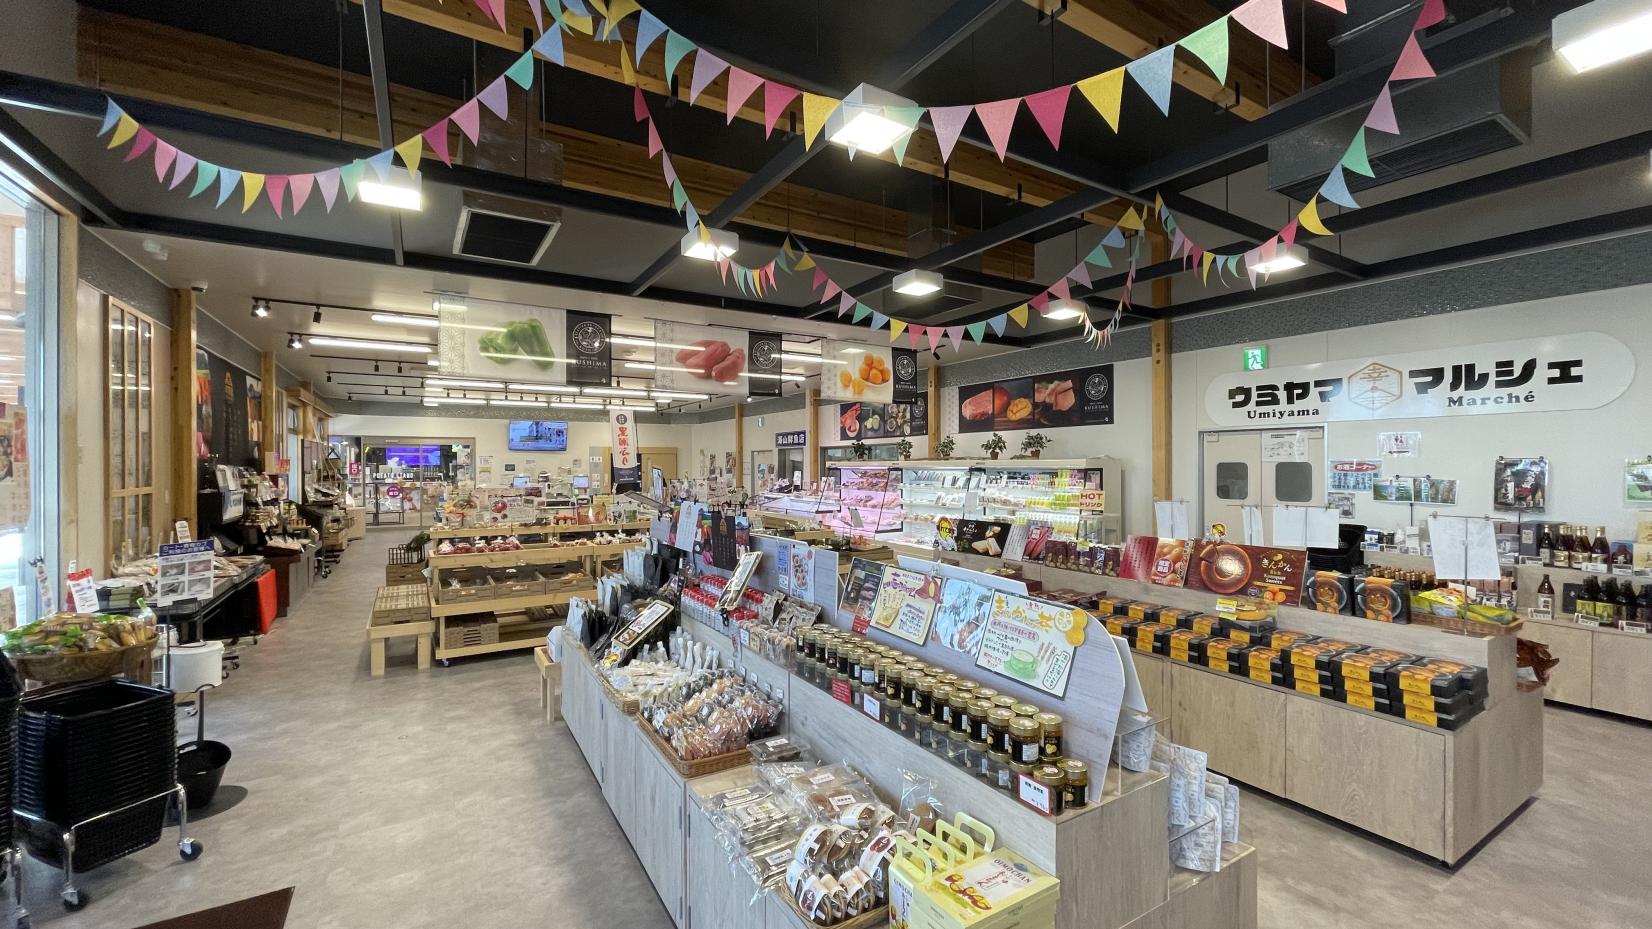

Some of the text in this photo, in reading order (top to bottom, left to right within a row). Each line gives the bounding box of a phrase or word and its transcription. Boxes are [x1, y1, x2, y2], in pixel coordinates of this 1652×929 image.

[1408, 357, 1583, 395] マルシェ
[1228, 377, 1343, 409] ウミヤマ
[1447, 390, 1536, 408] Marché
[1247, 407, 1320, 420] Umiyama
